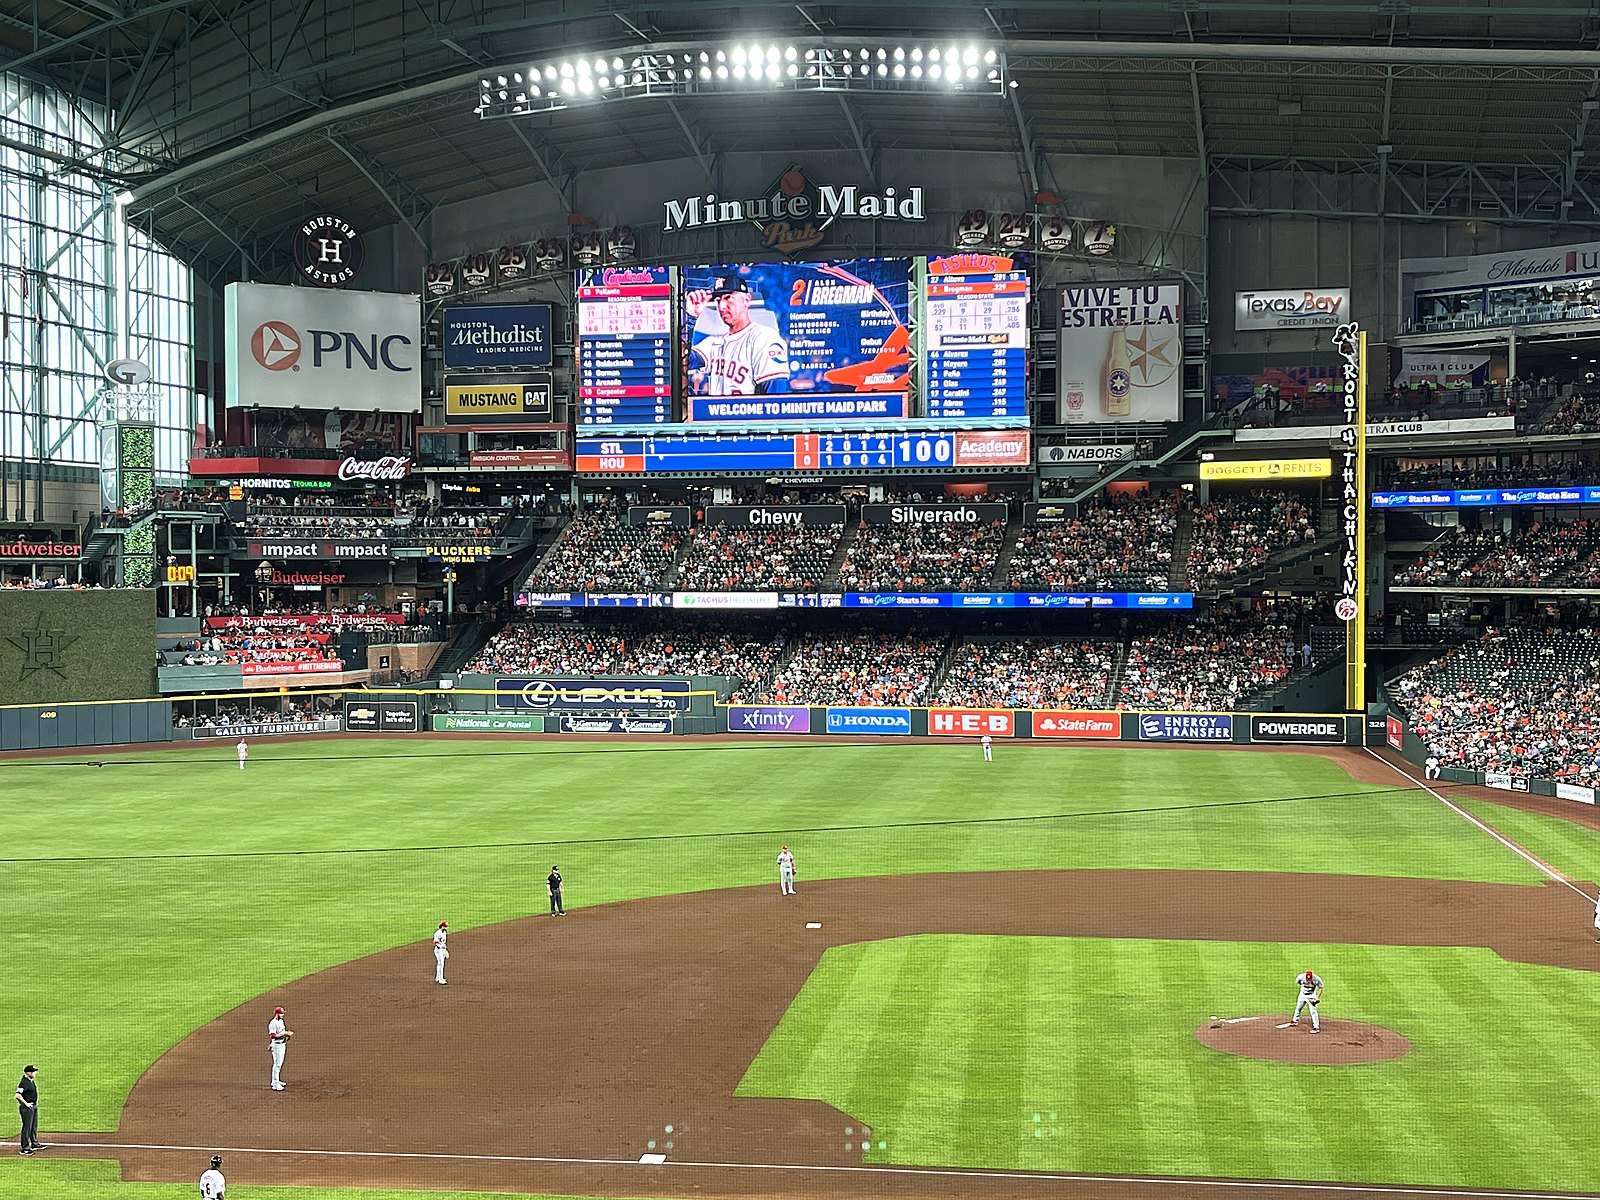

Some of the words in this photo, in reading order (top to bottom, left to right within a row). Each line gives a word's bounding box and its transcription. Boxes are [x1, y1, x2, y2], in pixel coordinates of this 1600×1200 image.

[663, 191, 810, 231] Minute
[818, 186, 925, 220] Maid
[959, 210, 986, 230] 49
[1000, 213, 1026, 233] 24
[1049, 216, 1063, 237] 5
[302, 217, 356, 239] HOUSTON
[766, 222, 822, 242] Park
[1090, 221, 1107, 242] 7
[318, 238, 342, 263] H
[499, 246, 523, 266] 25
[463, 254, 487, 273] 40
[941, 255, 998, 273] ASTROS
[1487, 257, 1563, 279] Michelob
[305, 265, 353, 283] ASTROS
[427, 263, 451, 282] 32
[603, 267, 654, 286] Cardinals
[790, 280, 806, 305] 2
[811, 285, 874, 305] BREGMAN
[1128, 285, 1158, 304] TU
[1243, 294, 1295, 312] Texas
[1303, 292, 1343, 315] Bay
[790, 312, 825, 320] Hometown
[861, 310, 890, 319] Birthday
[1061, 305, 1180, 328] ESTRELLA!
[451, 325, 543, 345] Methodist
[861, 338, 882, 346] Debut
[307, 330, 412, 372] PNC
[459, 393, 517, 407] MUSTANG
[525, 391, 547, 406] CAT
[1342, 364, 1357, 424] ROOT
[709, 403, 764, 416] WELCOME
[766, 405, 778, 415] TO
[782, 402, 824, 414] MINUTE
[826, 402, 855, 413] MAID
[857, 401, 887, 412] PARK
[1398, 424, 1422, 432] CLUB
[1342, 429, 1355, 444] 4
[601, 443, 623, 454] STL
[649, 444, 655, 453] 1
[804, 441, 809, 451] 1
[826, 441, 833, 451] 2
[843, 441, 851, 451] 0
[861, 441, 867, 451] 1
[878, 441, 886, 451] 4
[960, 441, 1022, 456] Academy
[1067, 448, 1122, 459] NABORS
[600, 458, 624, 469] HOU
[803, 455, 811, 465] 0
[826, 455, 832, 465] 1
[843, 455, 851, 465] 0
[860, 455, 868, 465] 0
[878, 454, 886, 465] 4
[1206, 465, 1264, 475] DOGGETT
[1284, 463, 1321, 473] RENTS
[1342, 452, 1356, 499] THA
[240, 478, 291, 488] HORNITOS
[1408, 495, 1431, 503] Starts
[1432, 494, 1450, 502] Here
[1537, 492, 1560, 500] Starts
[1561, 492, 1580, 500] Here
[749, 509, 802, 526] Chevy
[891, 507, 977, 523] Silverado
[0, 541, 81, 556] udweiser
[263, 544, 317, 558] impact
[335, 544, 387, 558] impact
[426, 546, 491, 556] PLUCKERS
[1343, 504, 1356, 594] CHIKIN
[168, 566, 194, 582] 0:09
[272, 571, 345, 583] Budweiser
[652, 594, 662, 606] K
[859, 596, 873, 604] The
[896, 596, 919, 604] Starts
[920, 596, 939, 604] Here
[963, 596, 991, 605] Academy
[1029, 597, 1044, 605] The
[1093, 597, 1113, 605] Here
[1138, 596, 1168, 605] Academy
[241, 617, 299, 627] Budweiser
[332, 615, 387, 625] Budweiser
[255, 664, 295, 672] Budweiser
[560, 688, 663, 703] LEXUS
[456, 719, 490, 728] National
[743, 709, 794, 729] xfinity
[844, 716, 908, 726] HONDA
[934, 714, 1008, 731] H-E-B
[1164, 717, 1217, 727] ENERGY
[216, 725, 261, 736] GALLERY
[263, 723, 319, 733] FURNITURE
[1166, 727, 1230, 738] TRANSFER
[1259, 722, 1337, 735] POWERADE
